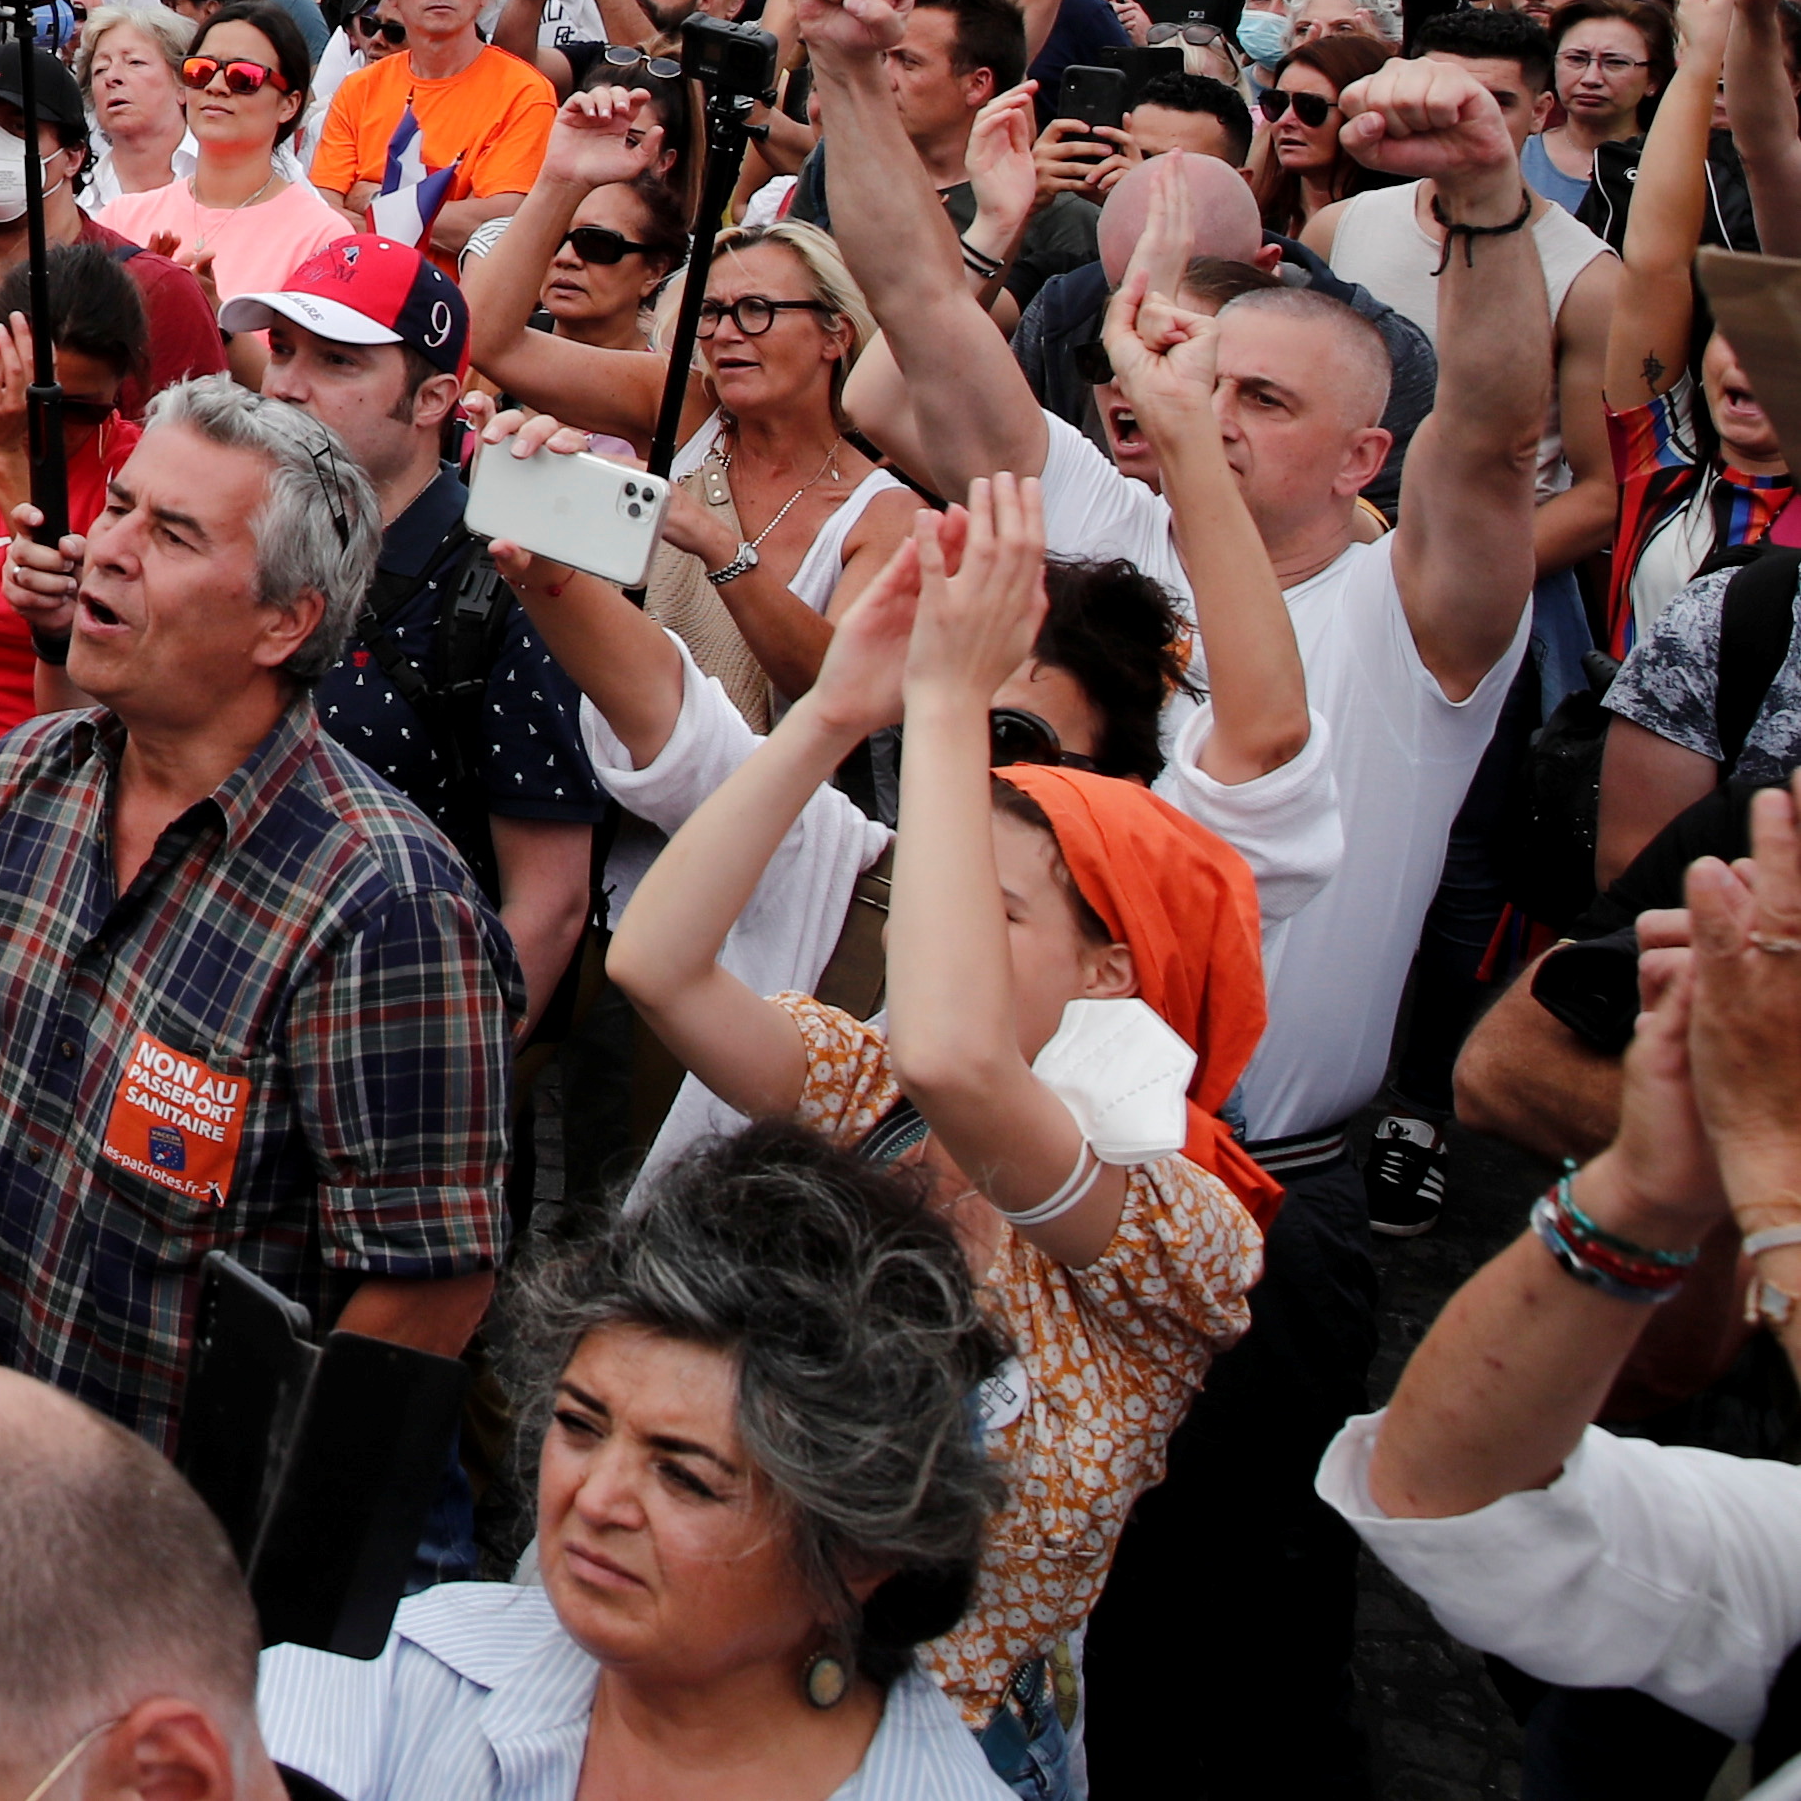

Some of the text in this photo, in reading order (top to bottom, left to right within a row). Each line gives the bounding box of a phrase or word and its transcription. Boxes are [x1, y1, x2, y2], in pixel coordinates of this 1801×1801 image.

[423, 300, 451, 347] 9
[127, 1065, 236, 1124] PASSEPORT
[134, 1040, 239, 1105] NON AU
[125, 1085, 226, 1143] SANITAIRE
[102, 1139, 200, 1196] les-patriotes.fr
